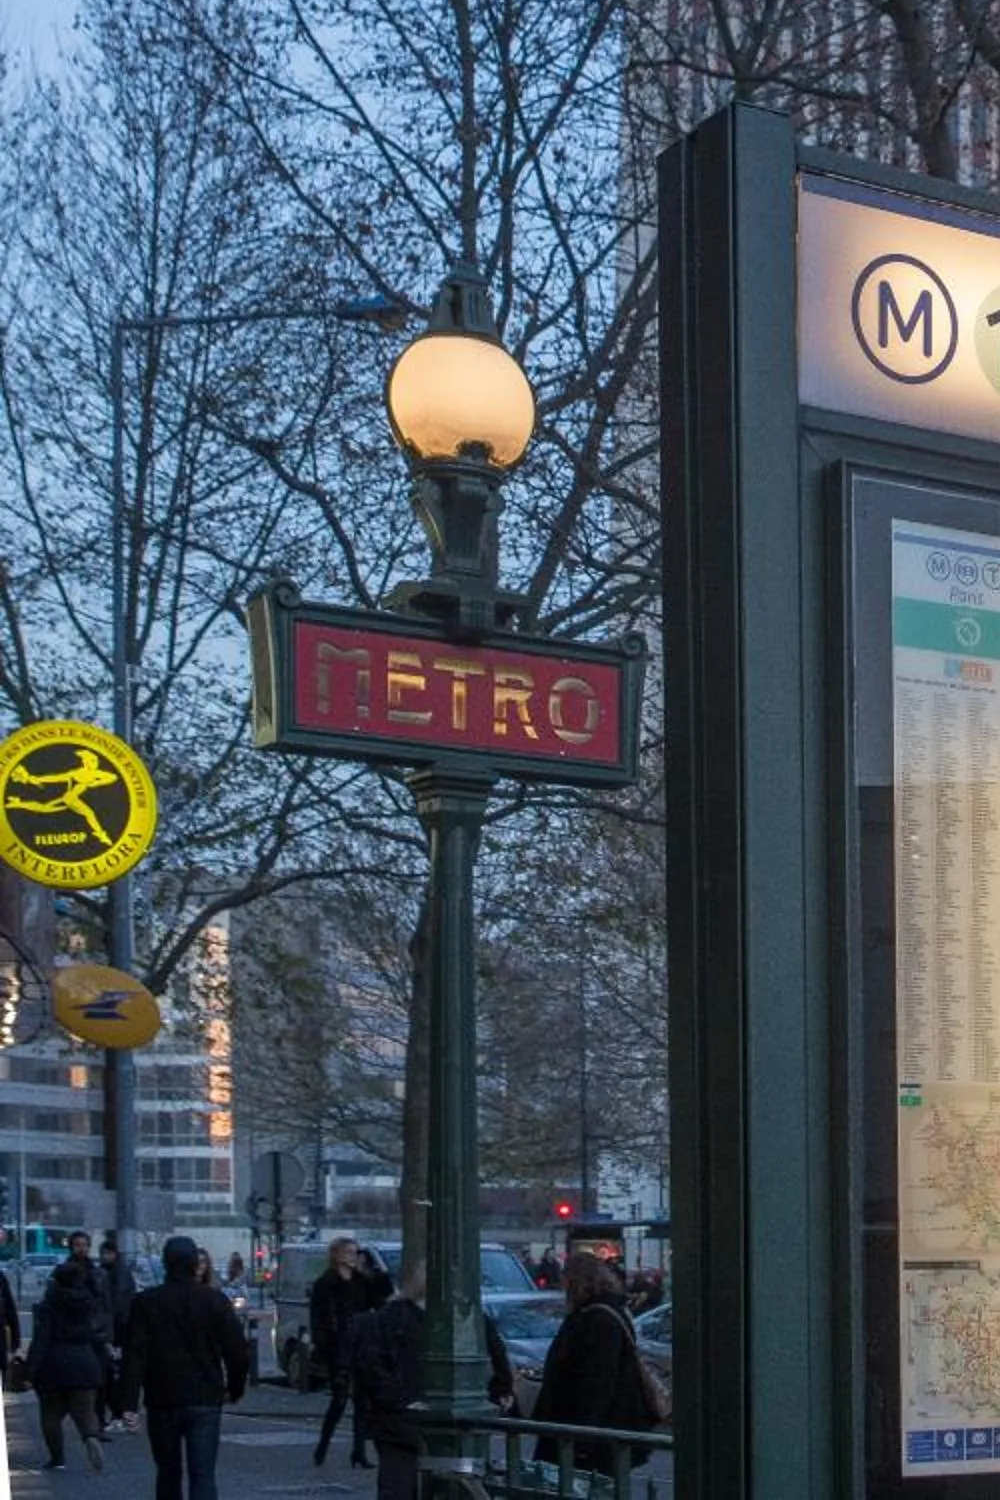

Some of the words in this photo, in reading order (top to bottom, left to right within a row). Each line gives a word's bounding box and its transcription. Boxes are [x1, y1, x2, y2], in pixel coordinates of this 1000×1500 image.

[877, 279, 932, 358] M
[316, 641, 597, 745] METRO
[6, 831, 143, 881] INTERFLORA
